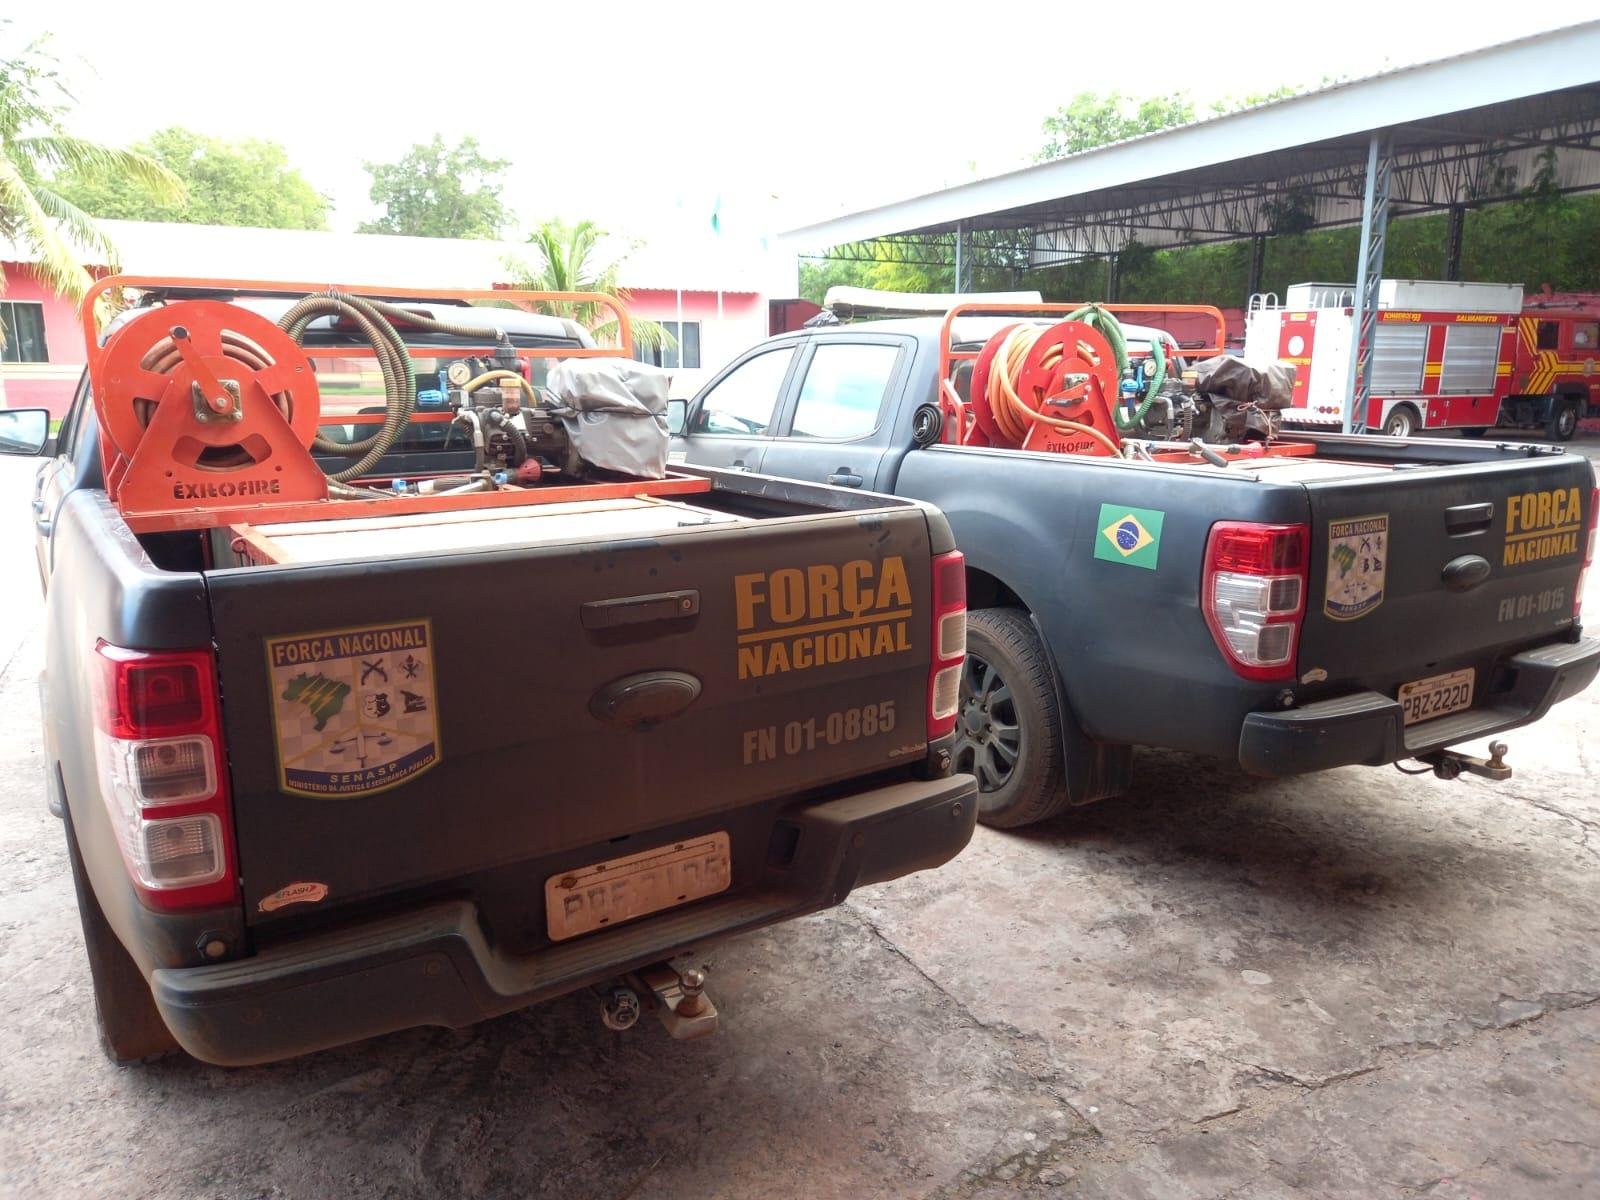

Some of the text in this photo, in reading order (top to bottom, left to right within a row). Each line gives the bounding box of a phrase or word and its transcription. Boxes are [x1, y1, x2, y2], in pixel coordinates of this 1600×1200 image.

[1506, 487, 1581, 534] FORÇA
[1503, 532, 1578, 566] NACIONAL
[735, 556, 912, 630] FORÇA
[1499, 598, 1516, 622] FN
[275, 628, 424, 664] FORÇA NACIONAL
[738, 622, 912, 680] NACIONAL
[743, 700, 896, 765] FN 01-0885
[330, 763, 397, 783] SENASP
